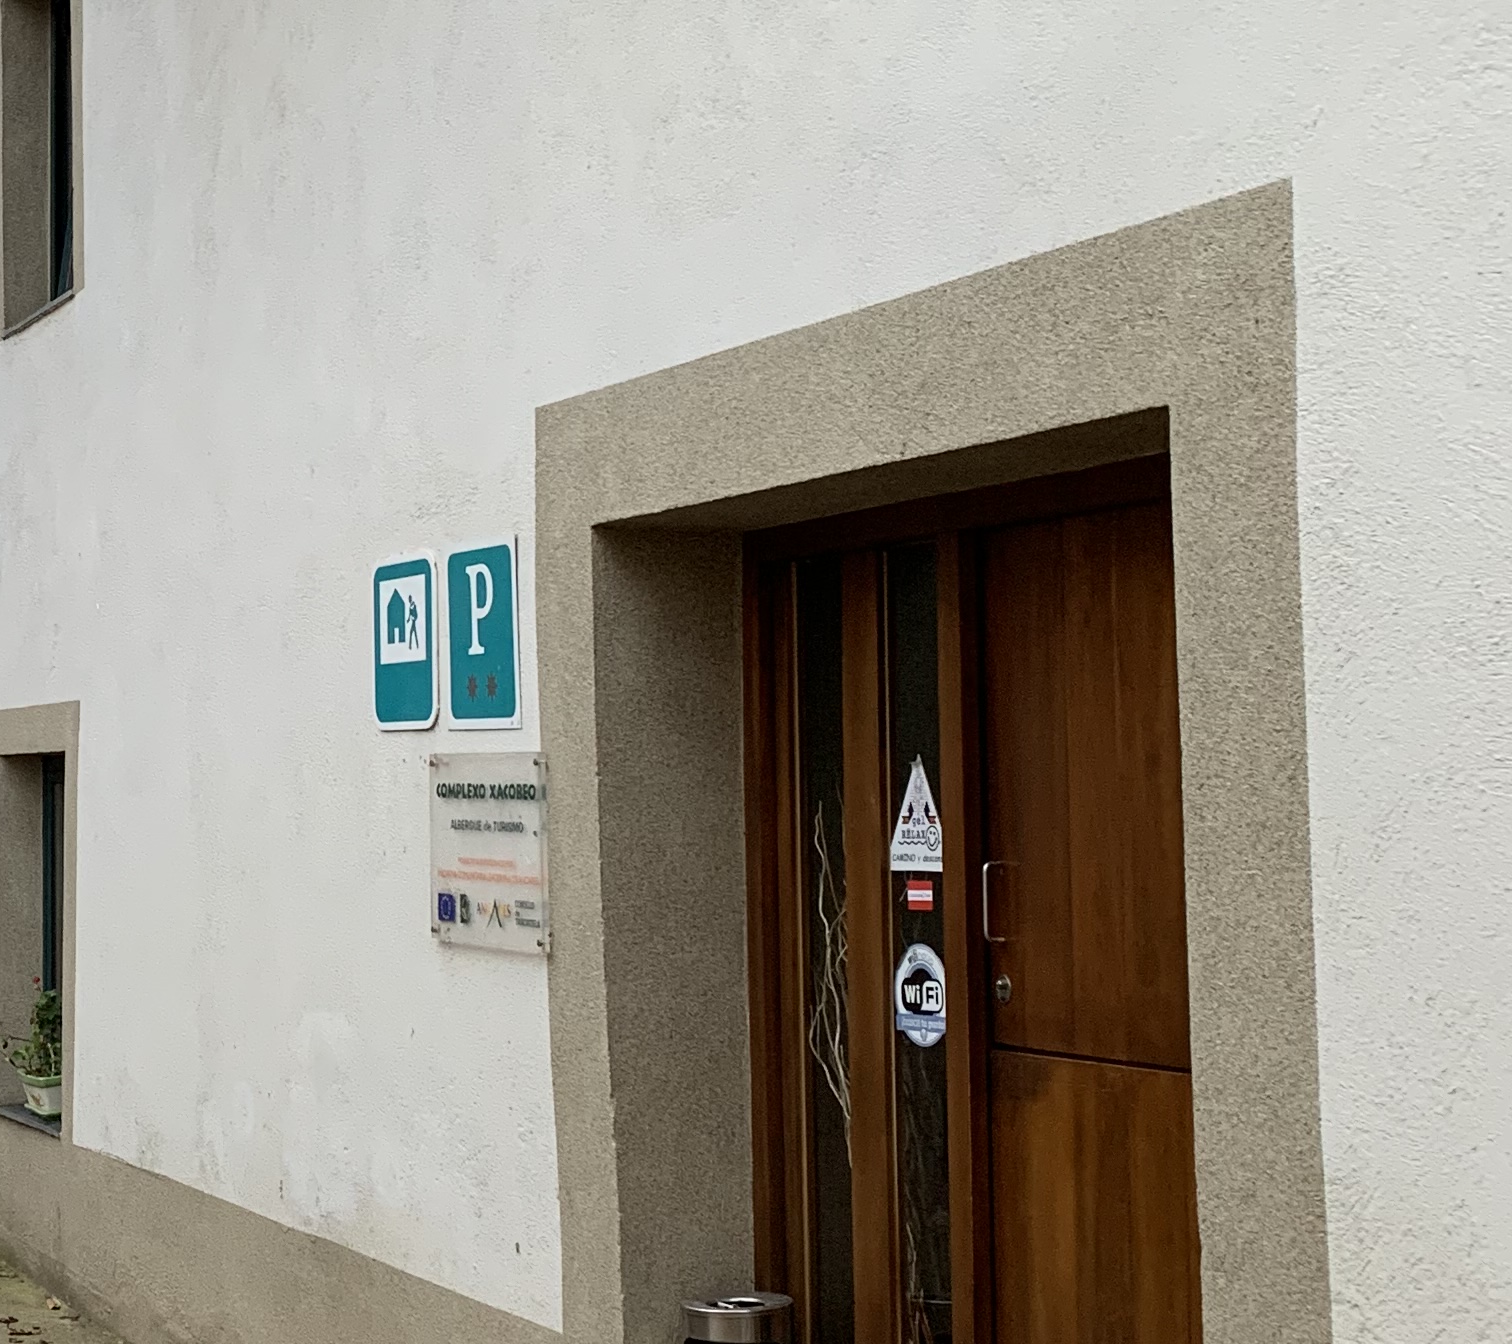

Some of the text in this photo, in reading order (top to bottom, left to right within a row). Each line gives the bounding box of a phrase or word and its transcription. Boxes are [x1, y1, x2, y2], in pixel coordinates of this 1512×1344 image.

[465, 562, 494, 656] P
[436, 782, 536, 800] COMPLEXO XACOBEO
[450, 819, 482, 831] ALBERGUE
[493, 821, 524, 833] TURISMO
